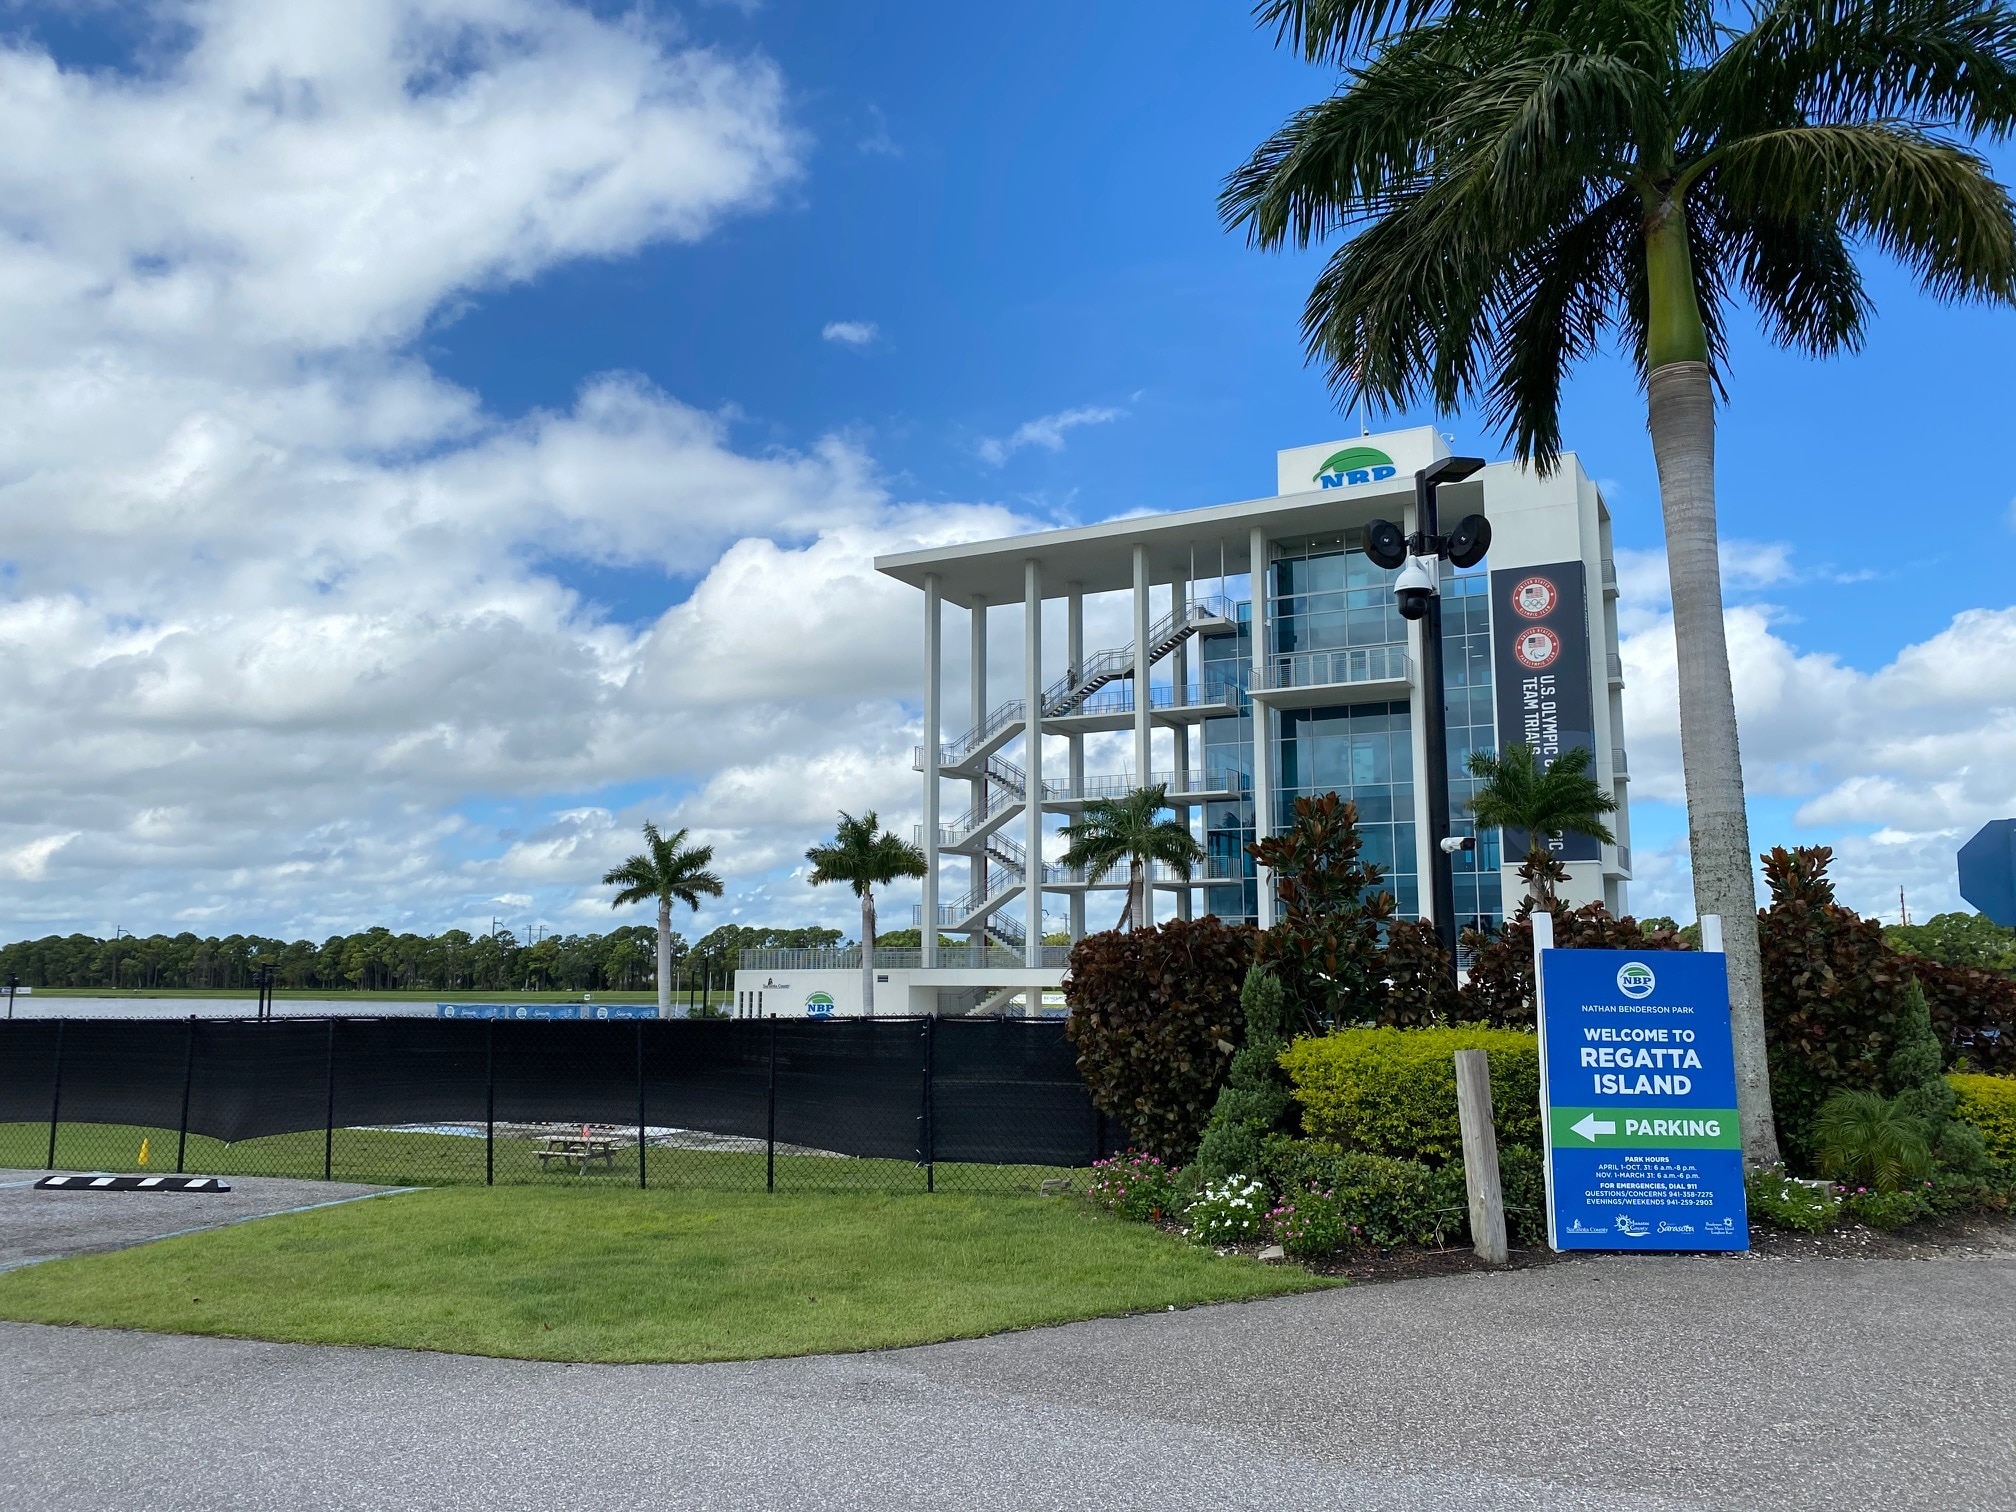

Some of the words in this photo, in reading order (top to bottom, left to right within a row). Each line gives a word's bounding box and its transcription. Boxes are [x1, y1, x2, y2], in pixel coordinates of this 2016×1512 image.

[1522, 676, 1539, 710] TEAM
[1540, 675, 1556, 699] U.S.
[1541, 701, 1559, 755] OLYMPIC
[1622, 976, 1652, 985] NBP
[807, 1004, 835, 1012] NBP
[1581, 1005, 1617, 1013] NATHAN
[1618, 1005, 1670, 1014] BENDERSON
[1672, 1006, 1694, 1014] PARK
[1583, 1028, 1669, 1043] WELCOME
[1672, 1029, 1695, 1043] TO
[1580, 1047, 1703, 1069] REGATTA
[1594, 1073, 1692, 1095] ISLAND
[1625, 1119, 1721, 1137] PARKING
[1584, 1190, 1667, 1198] QUESTIONS/CONCERNS
[1586, 1198, 1665, 1206] EVENINGS/WEEKENDS
